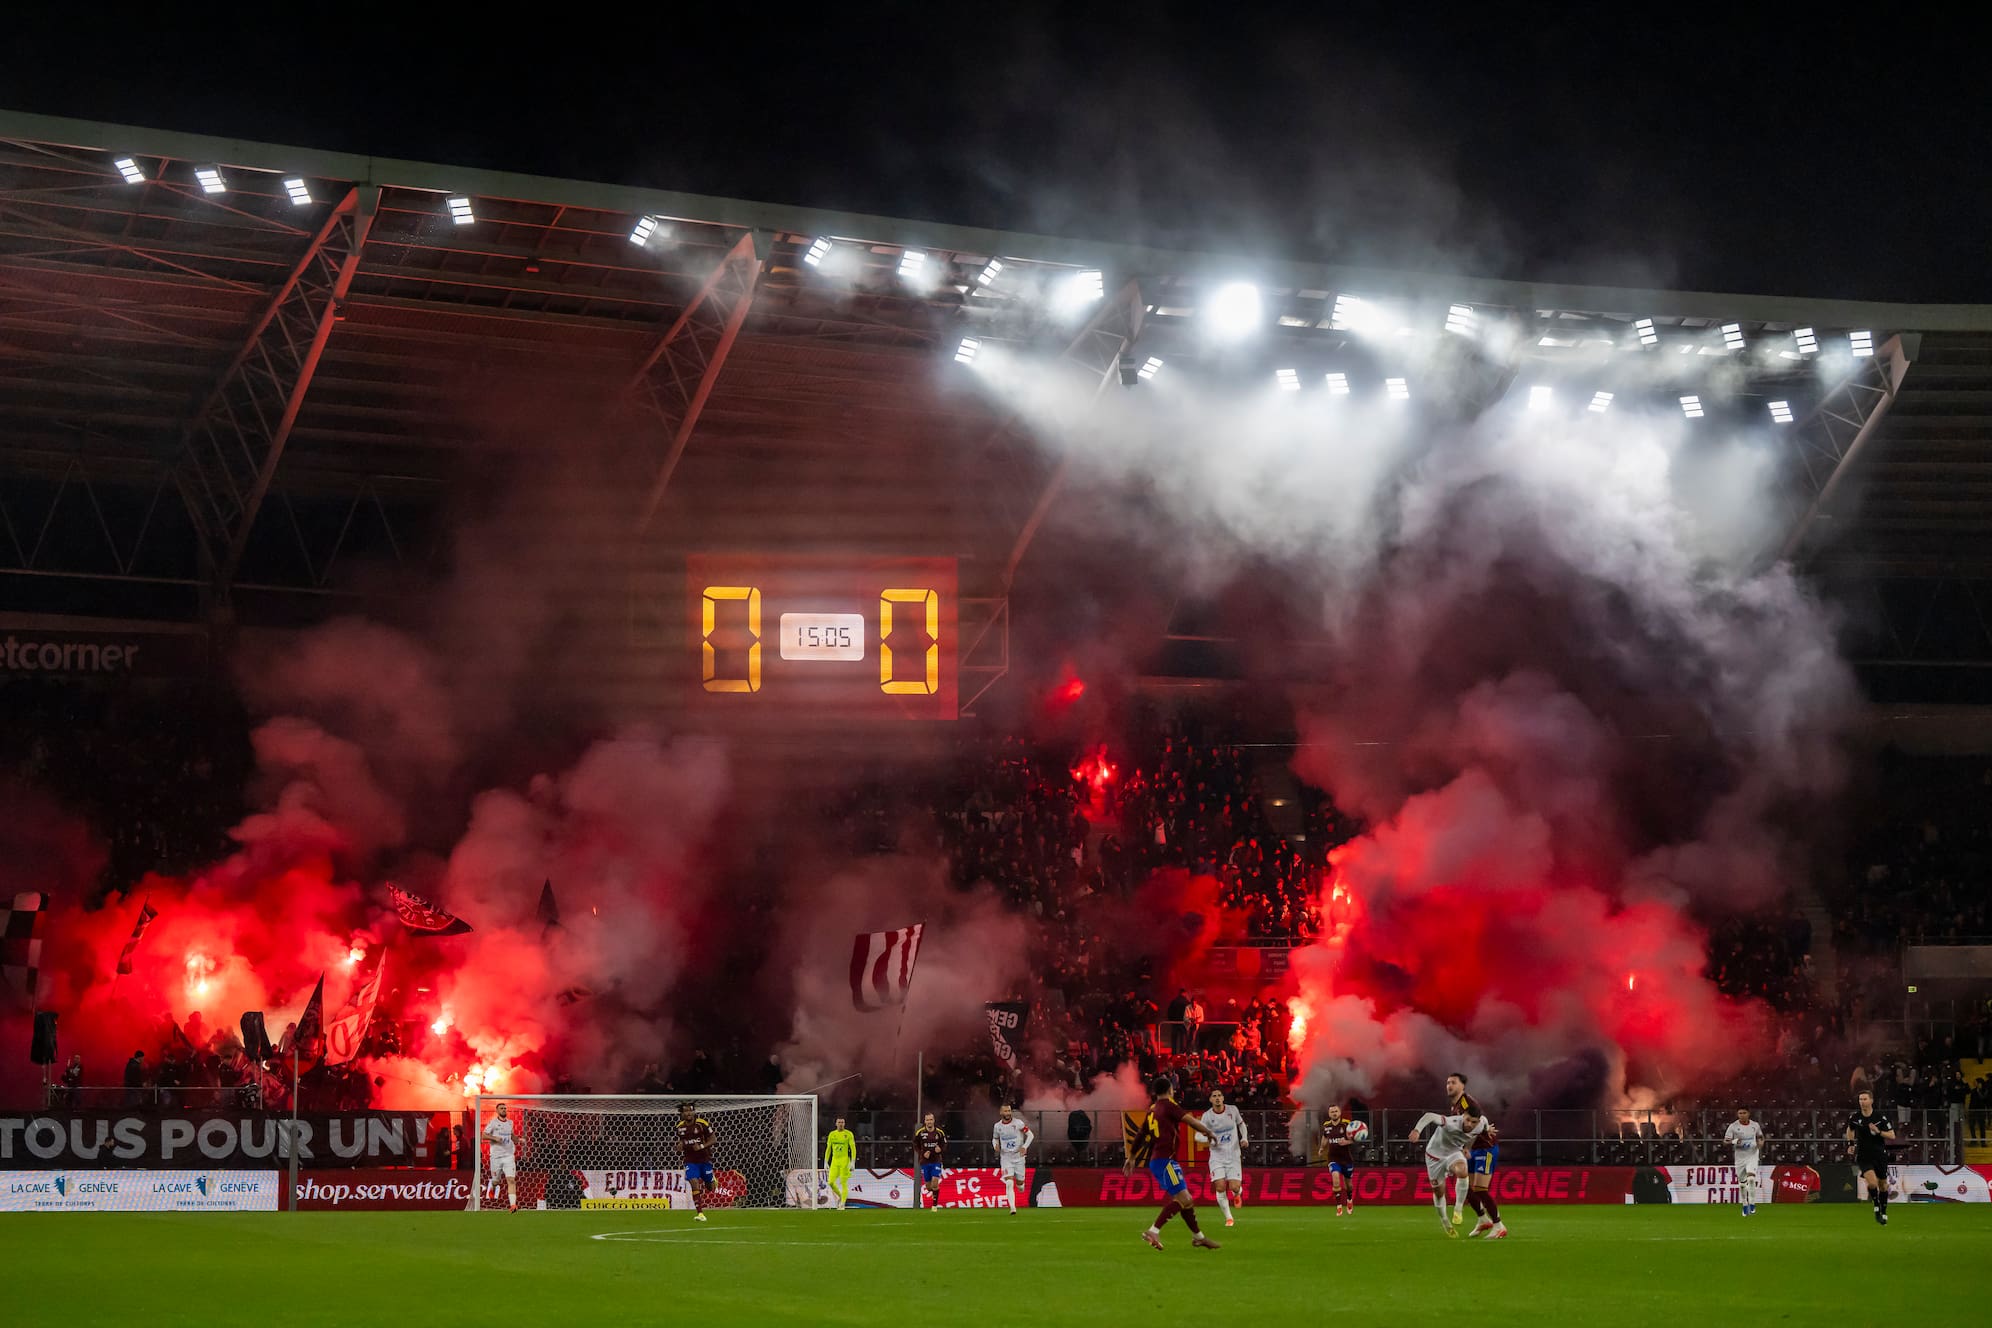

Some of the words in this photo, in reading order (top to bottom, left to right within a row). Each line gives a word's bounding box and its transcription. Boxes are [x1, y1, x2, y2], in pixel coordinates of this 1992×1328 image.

[703, 586, 761, 693] 0
[799, 627, 850, 647] 15:05
[880, 589, 938, 694] 0
[0, 635, 139, 672] tcorner
[0, 1117, 146, 1160] TOUS
[161, 1118, 314, 1160] POUR
[329, 1118, 403, 1158] UN
[415, 1117, 429, 1157] !
[11, 1183, 24, 1193] LA
[25, 1183, 50, 1193] CAVE
[153, 1183, 166, 1193] LA
[167, 1183, 192, 1193] CAVE
[605, 1171, 687, 1193] FOOTBAL
[956, 1177, 981, 1194] FC
[1259, 1172, 1302, 1200] LE
[1491, 1170, 1574, 1199] IGNE
[1578, 1170, 1590, 1198] !
[1789, 1182, 1808, 1192] MSC
[938, 1194, 1009, 1208] NÈVE
[1707, 1187, 1740, 1203] CLU
